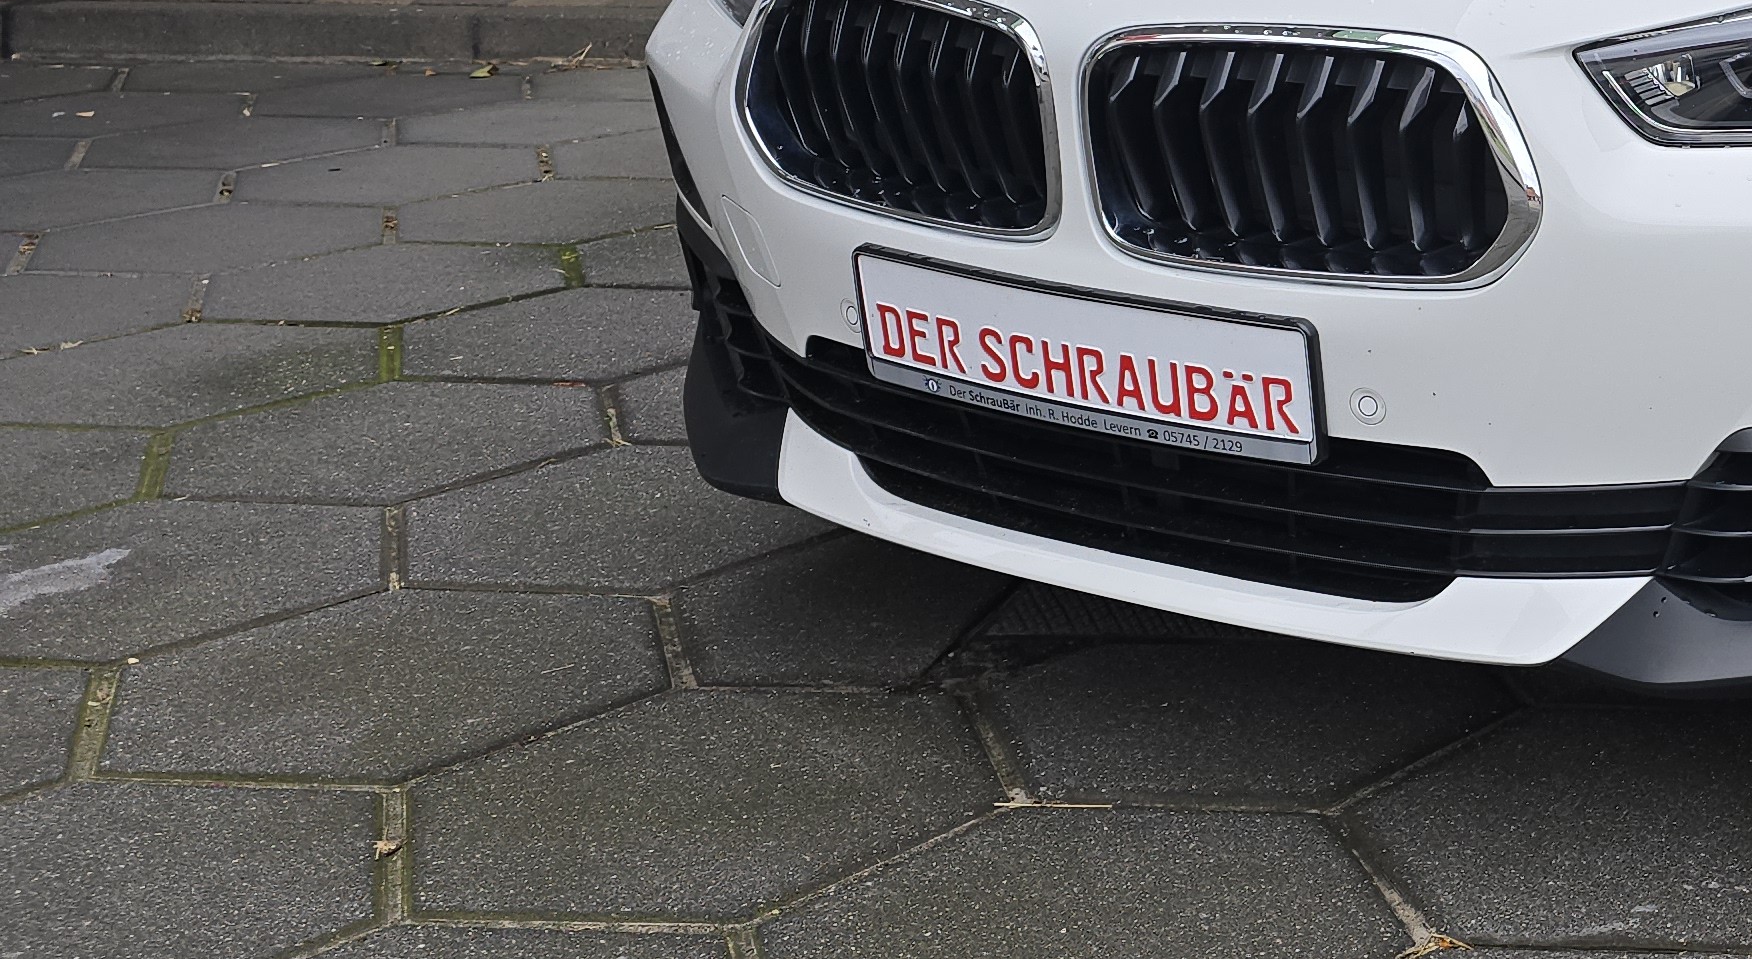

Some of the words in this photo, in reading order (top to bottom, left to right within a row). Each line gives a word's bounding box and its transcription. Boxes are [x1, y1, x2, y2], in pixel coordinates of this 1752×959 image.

[876, 301, 968, 375] DER
[978, 326, 1300, 435] SCHRAUBÄR
[949, 384, 967, 400] Der
[969, 389, 1021, 413] SchrauBär
[1025, 403, 1047, 418] Inh.
[1048, 408, 1060, 422] R.
[1061, 411, 1098, 429] Hodde
[1103, 419, 1142, 437] Levern
[1163, 429, 1200, 447] 05745
[1211, 437, 1243, 453] 2129
